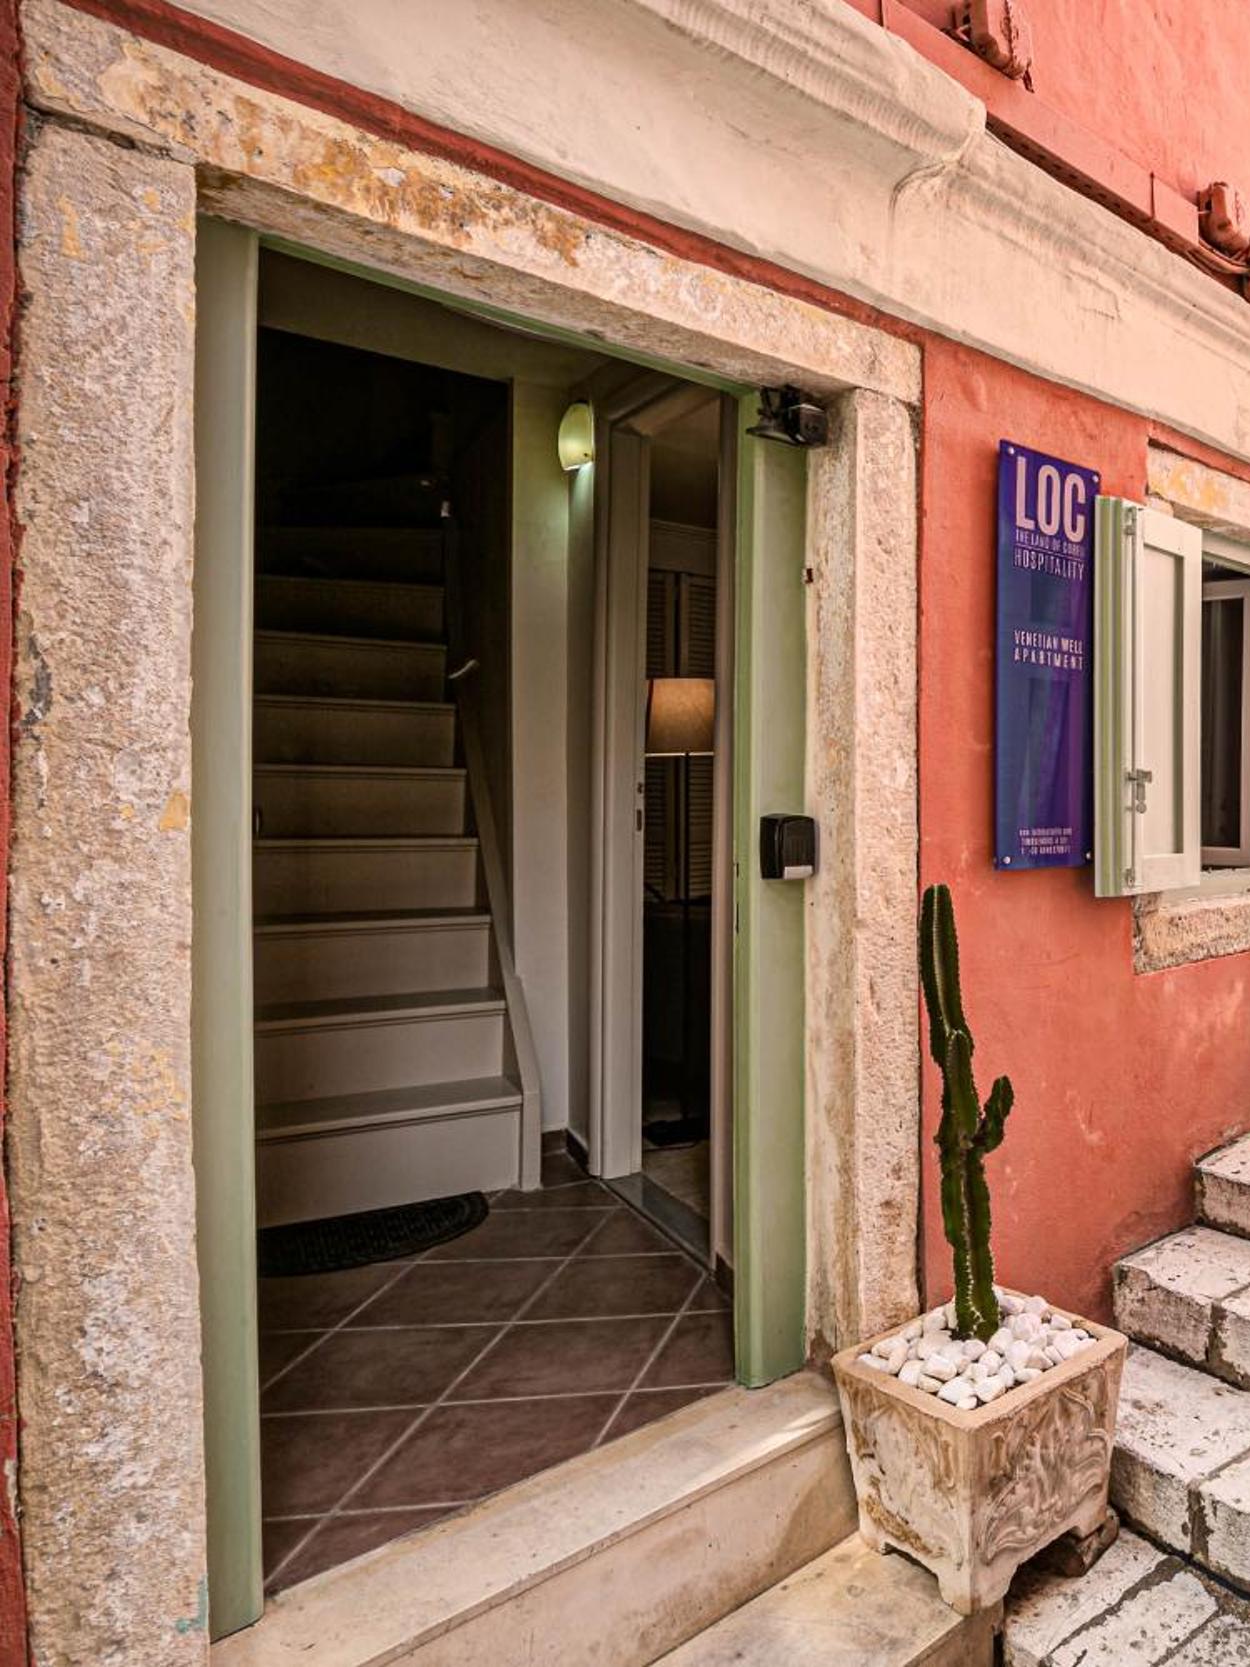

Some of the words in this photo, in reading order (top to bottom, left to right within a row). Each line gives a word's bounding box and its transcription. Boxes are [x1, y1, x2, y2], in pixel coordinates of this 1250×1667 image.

[1016, 455, 1086, 543] LOC
[1016, 529, 1030, 544] THE
[1014, 548, 1084, 580] HOSPITALITY
[1014, 630, 1059, 650] VENETIAN
[1061, 637, 1083, 654] WELL
[1014, 648, 1083, 670] APARTMENT
